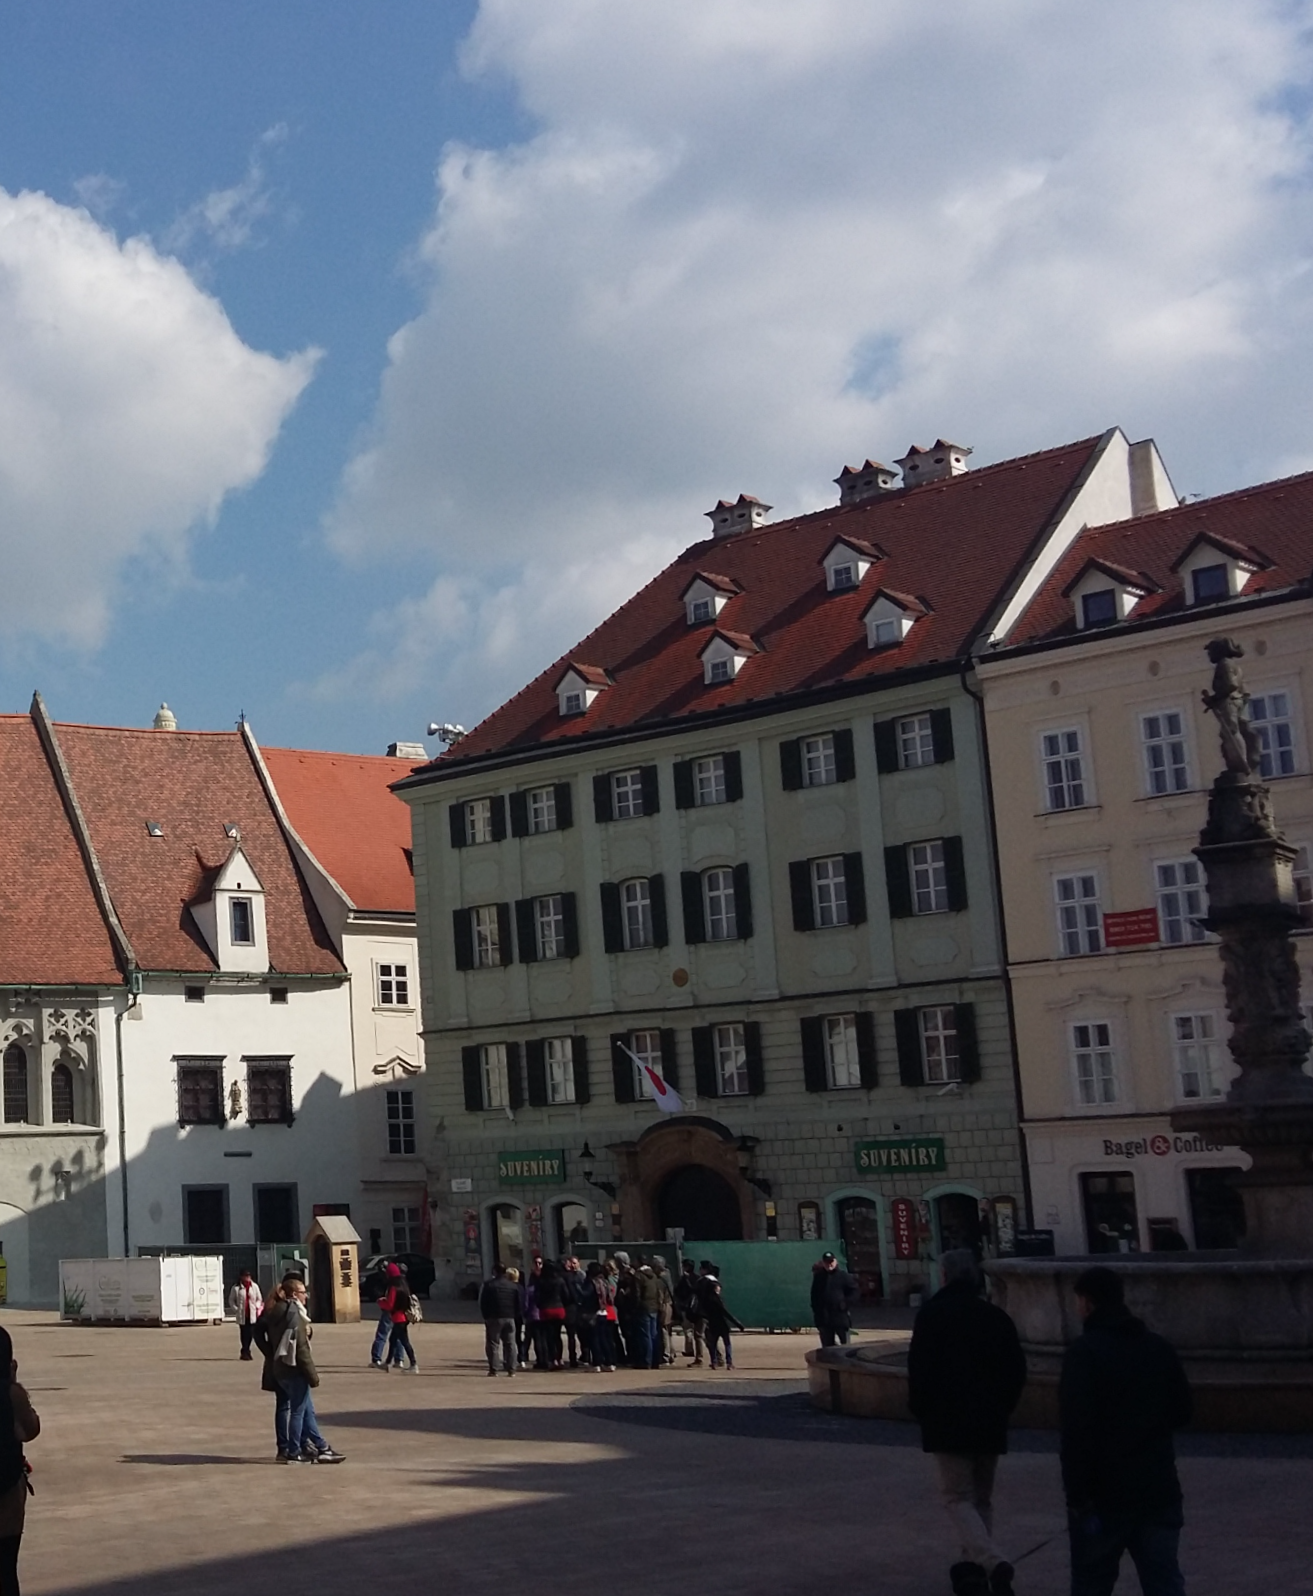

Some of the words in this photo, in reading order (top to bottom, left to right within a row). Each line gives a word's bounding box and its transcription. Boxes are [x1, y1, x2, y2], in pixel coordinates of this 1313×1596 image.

[859, 1143, 938, 1168] SUVENÍRY
[1102, 1138, 1149, 1158] Bagel
[499, 1155, 559, 1178] SUVENÍRY
